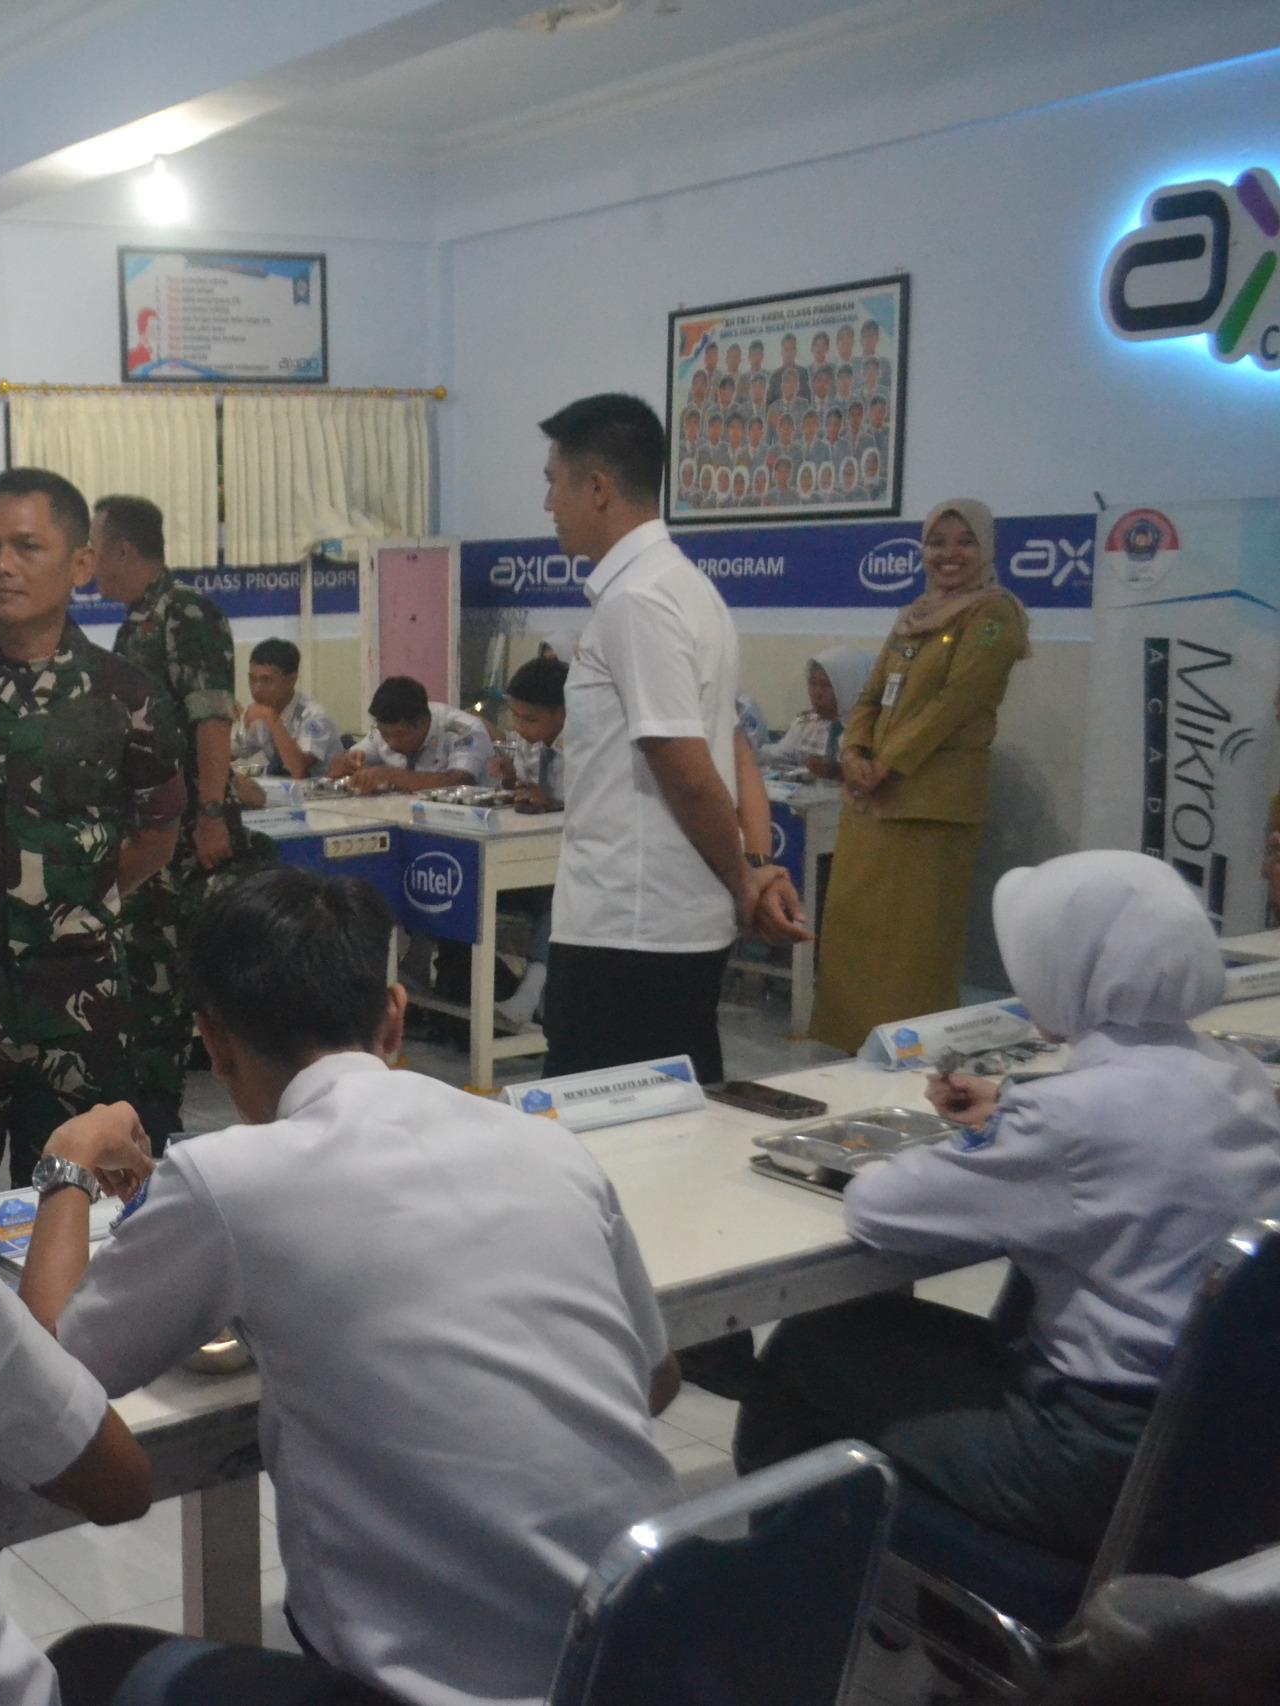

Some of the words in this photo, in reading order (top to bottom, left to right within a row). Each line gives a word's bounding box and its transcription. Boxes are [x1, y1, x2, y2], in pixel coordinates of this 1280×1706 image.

[697, 556, 784, 576] PROGRAM
[867, 551, 914, 576] intel
[194, 573, 241, 591] CLASS
[246, 571, 299, 589] PROGR
[411, 864, 454, 896] intel
